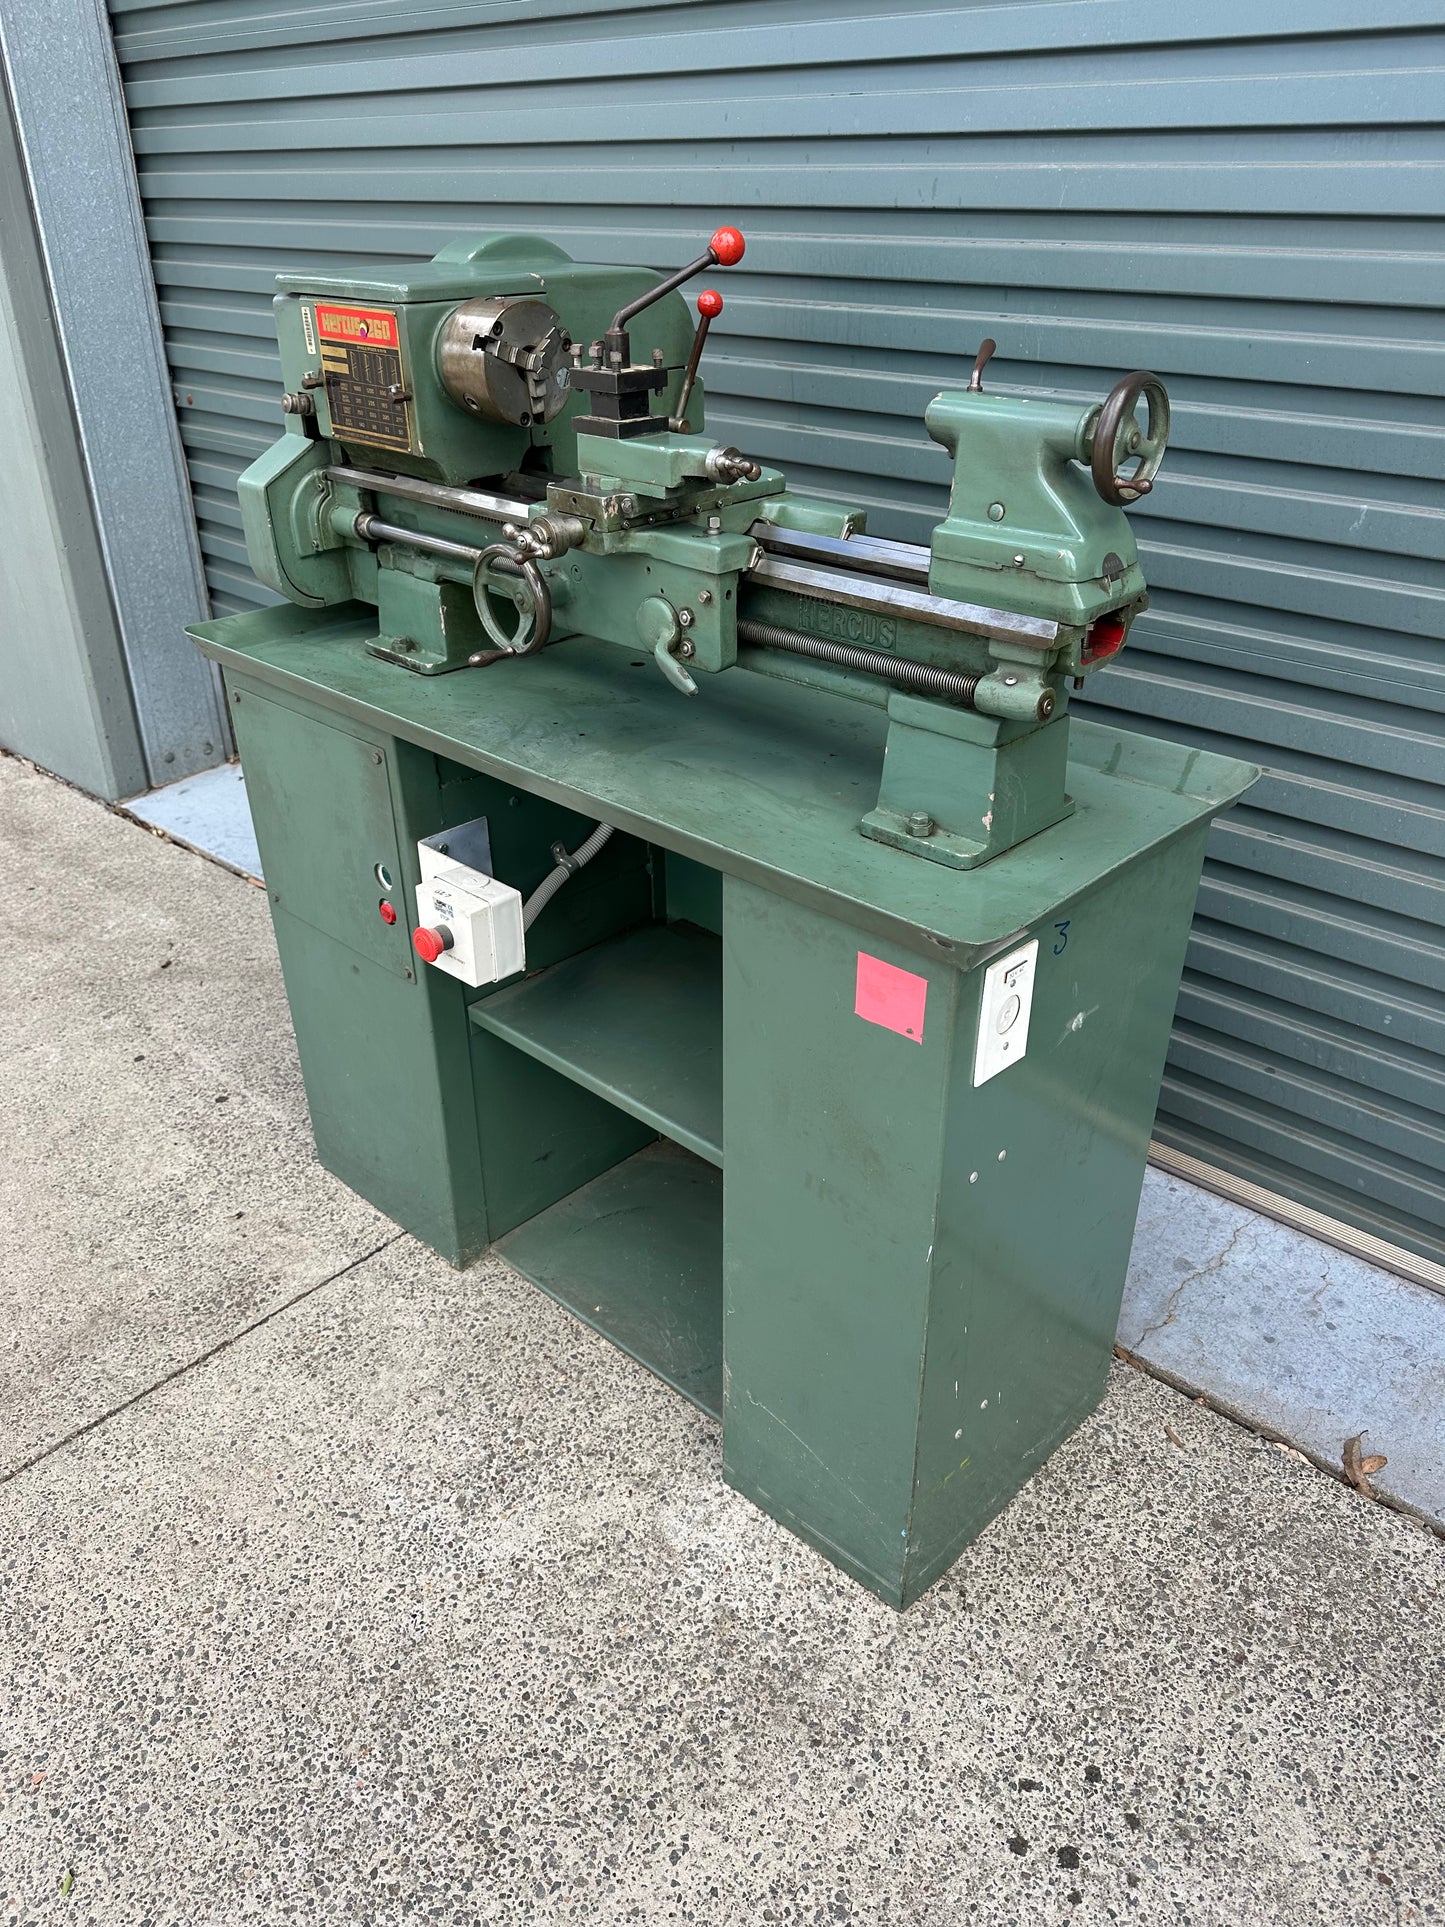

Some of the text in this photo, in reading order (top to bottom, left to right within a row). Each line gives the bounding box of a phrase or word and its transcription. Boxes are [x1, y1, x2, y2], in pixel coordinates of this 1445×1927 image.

[367, 319, 390, 340] 260
[799, 599, 896, 648] HERCUS
[1053, 920, 1071, 955] 3
